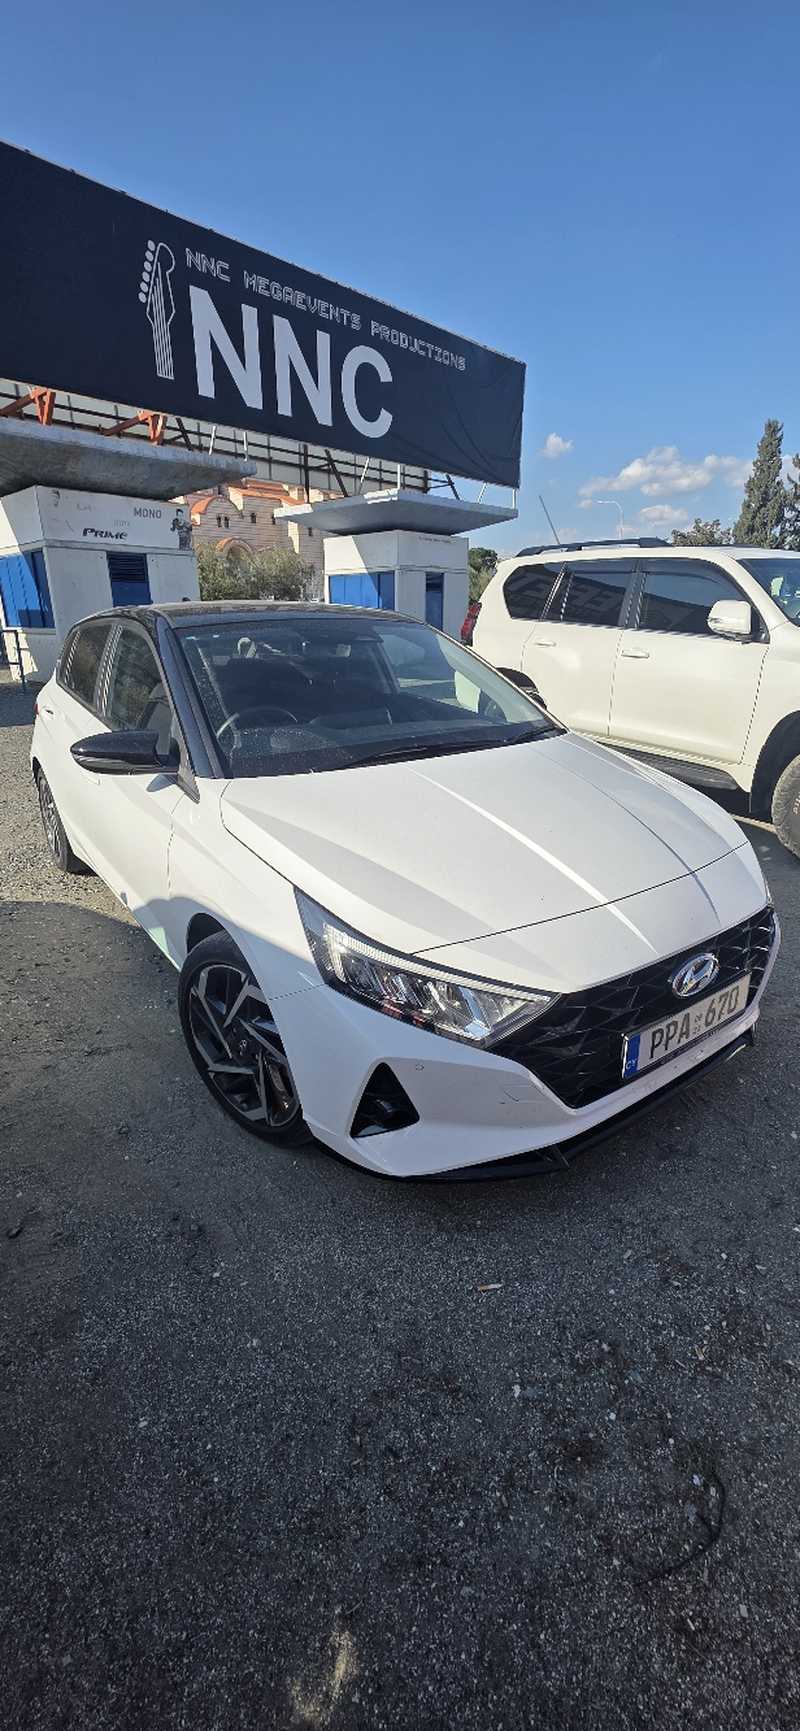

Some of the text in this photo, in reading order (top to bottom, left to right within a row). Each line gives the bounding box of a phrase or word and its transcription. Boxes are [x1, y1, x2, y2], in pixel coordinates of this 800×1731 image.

[185, 247, 467, 372] NNC MEGAEVENTS PRODUCTIONS
[189, 285, 393, 439] NNC
[134, 508, 162, 519] MONO
[650, 1013, 690, 1059] PPA
[704, 986, 740, 1026] 670
